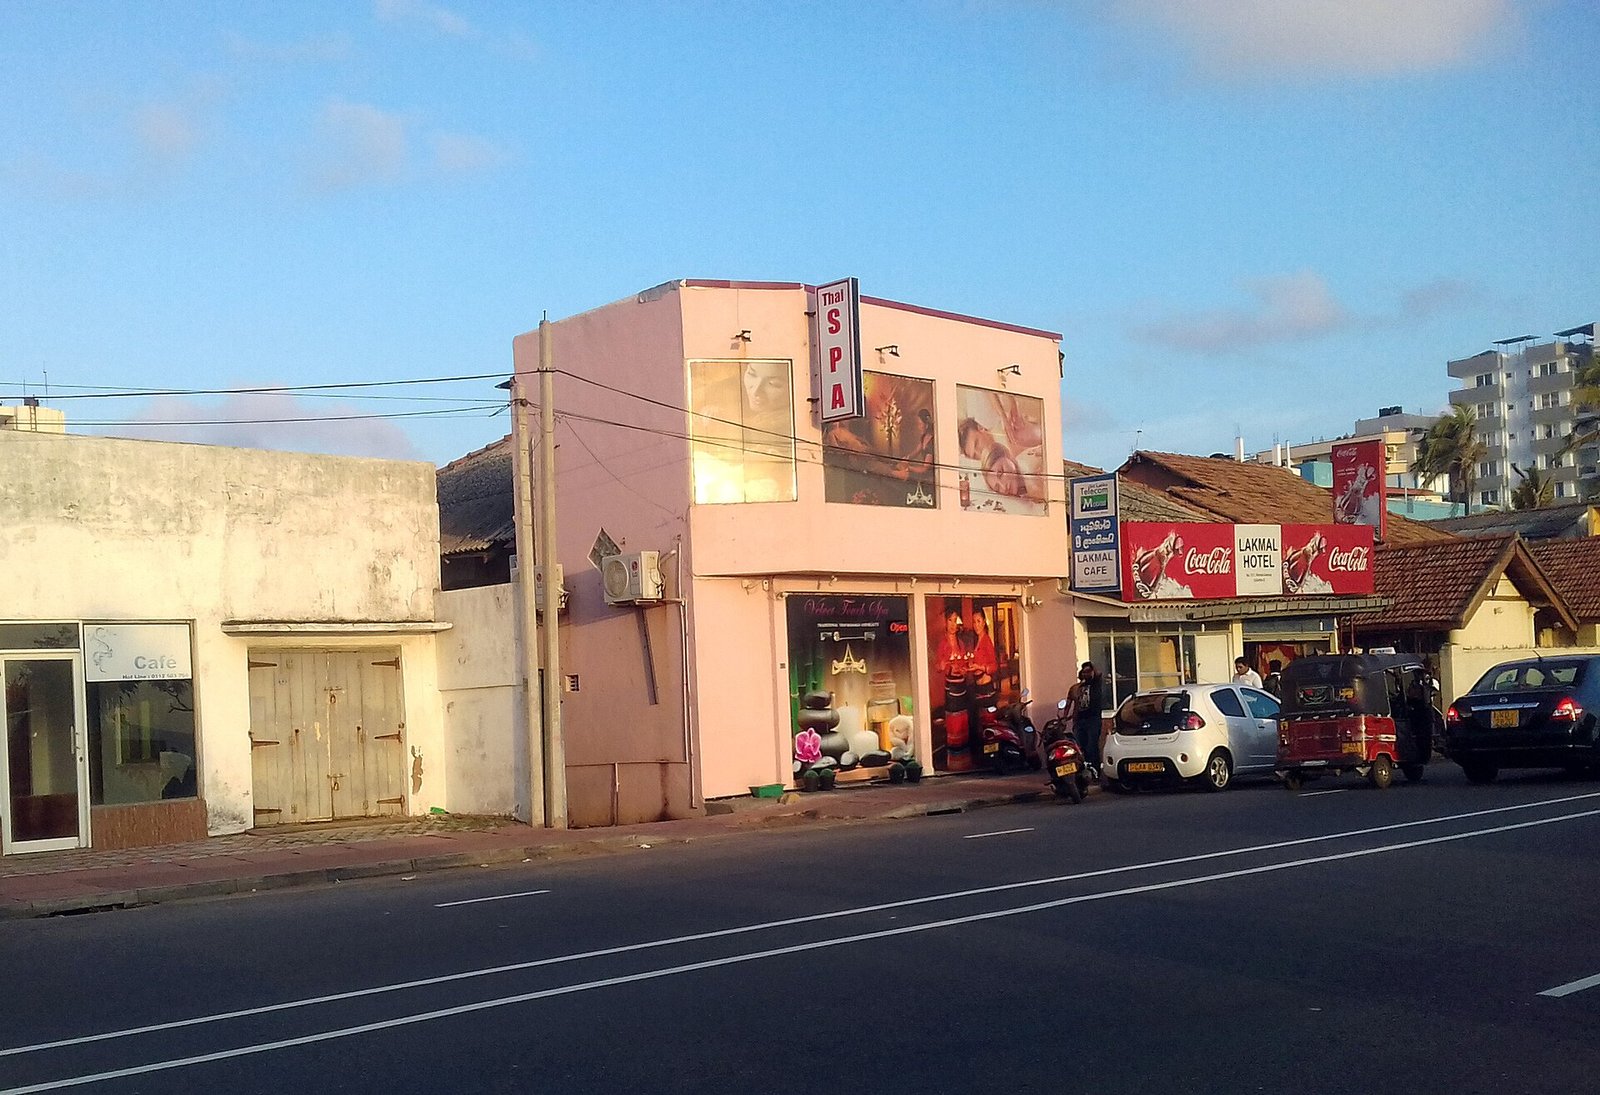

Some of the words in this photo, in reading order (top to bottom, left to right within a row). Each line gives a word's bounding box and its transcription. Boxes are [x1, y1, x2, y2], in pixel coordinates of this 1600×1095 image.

[822, 289, 844, 306] Thai
[1080, 487, 1108, 496] Telecom
[1239, 538, 1278, 552] LAKMAL
[1077, 552, 1113, 563] LAKMAL
[1184, 547, 1232, 575] Coca-Cola
[1243, 555, 1275, 568] HOTEL
[1328, 546, 1371, 572] Coca-Cola
[1083, 566, 1107, 576] CAFE
[890, 622, 908, 633] Open
